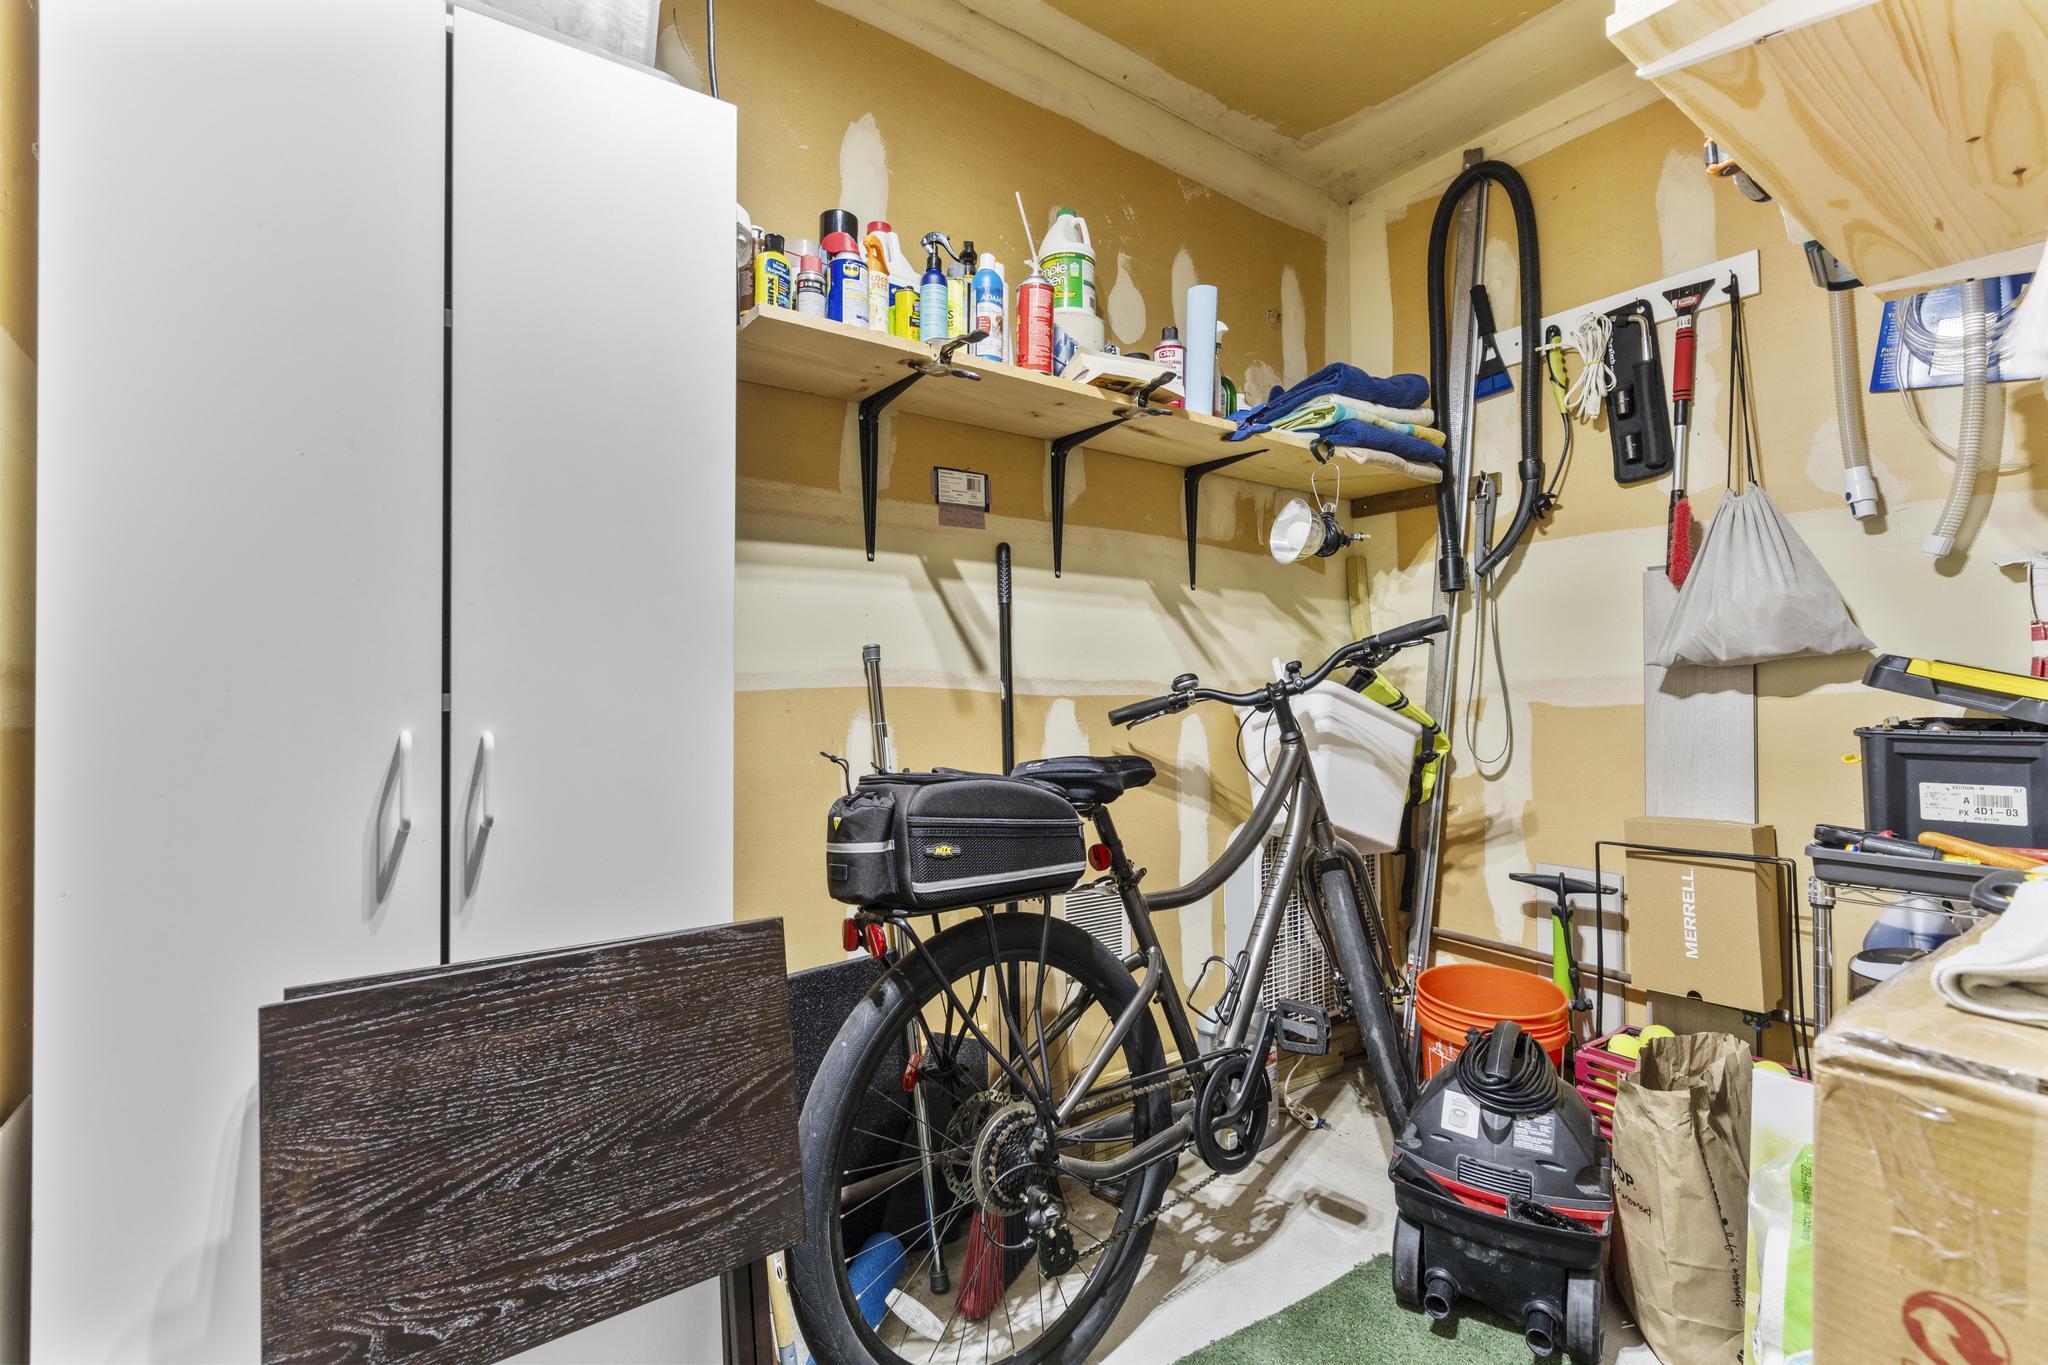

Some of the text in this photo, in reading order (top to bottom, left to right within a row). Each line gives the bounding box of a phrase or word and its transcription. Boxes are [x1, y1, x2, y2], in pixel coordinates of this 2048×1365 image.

[1042, 262, 1068, 278] mple
[1159, 350, 1176, 358] CRC
[934, 846, 952, 856] MTX
[1681, 867, 1700, 960] MERRELL
